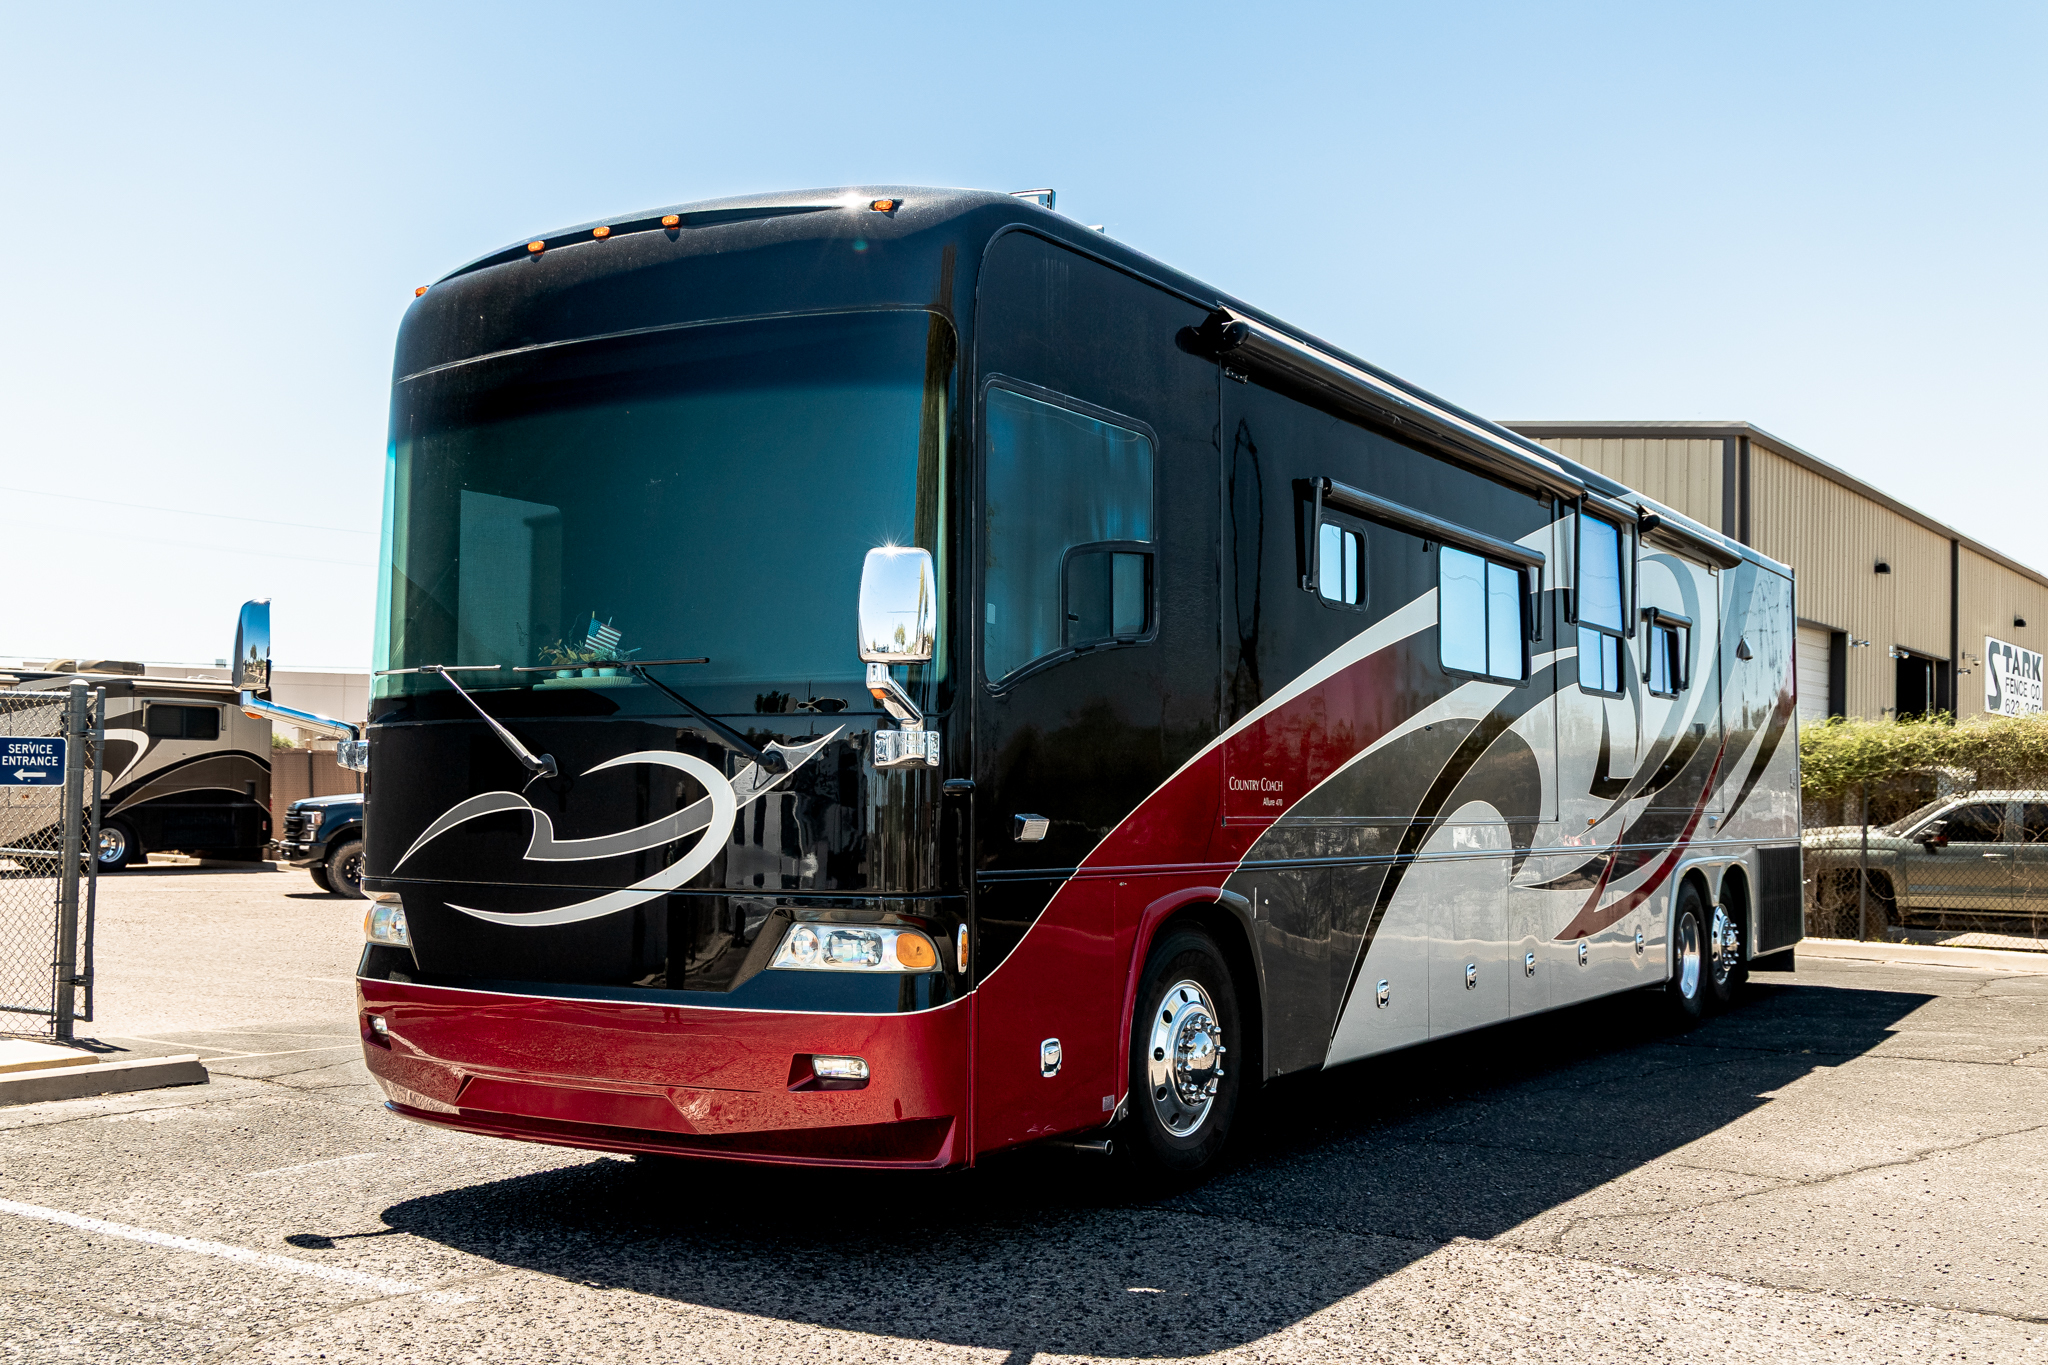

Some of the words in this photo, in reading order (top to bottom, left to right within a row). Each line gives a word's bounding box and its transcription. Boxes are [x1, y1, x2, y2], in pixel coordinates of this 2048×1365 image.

[1988, 641, 2042, 711] STARK
[2005, 677, 2028, 698] FENCE
[8, 743, 53, 755] SERVICE
[2, 756, 59, 766] ENTRANCE
[1229, 776, 1260, 791] COUNTRY
[1261, 777, 1284, 792] COACH
